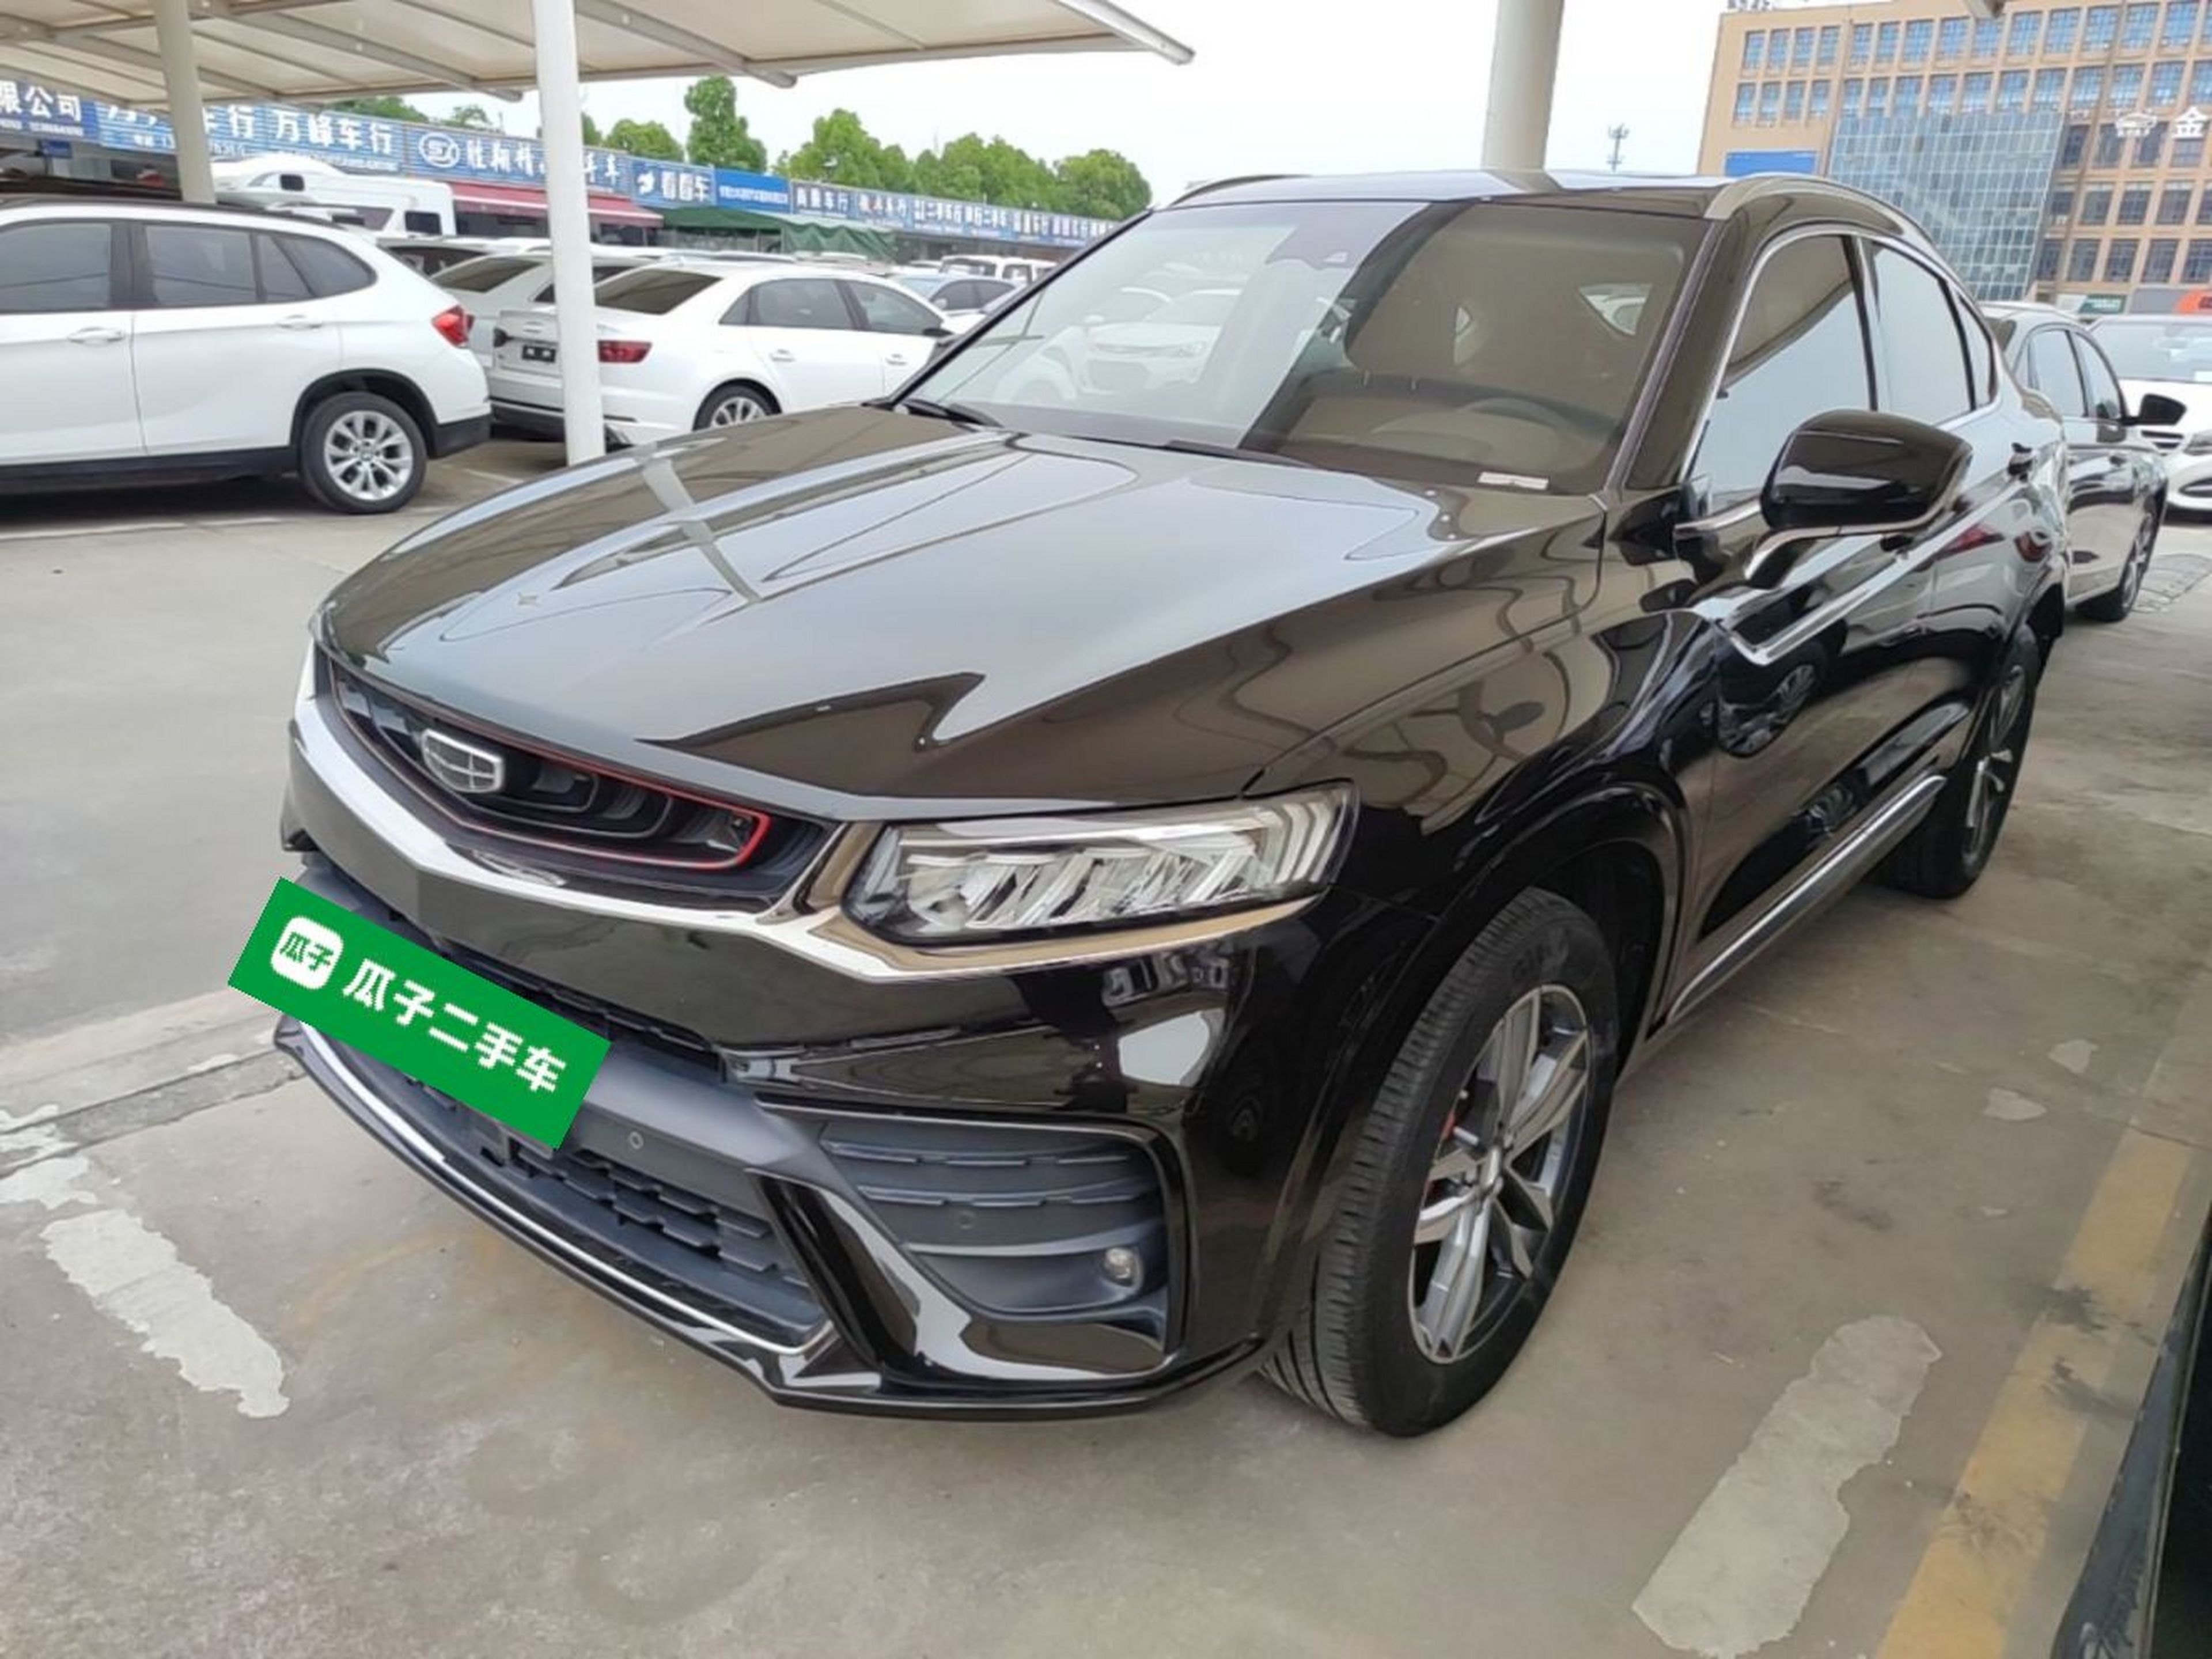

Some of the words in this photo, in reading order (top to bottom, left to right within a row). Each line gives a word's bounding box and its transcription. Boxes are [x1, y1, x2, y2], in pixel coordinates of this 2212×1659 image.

[274, 109, 393, 154] 万峰车行
[2172, 106, 2209, 138] 金
